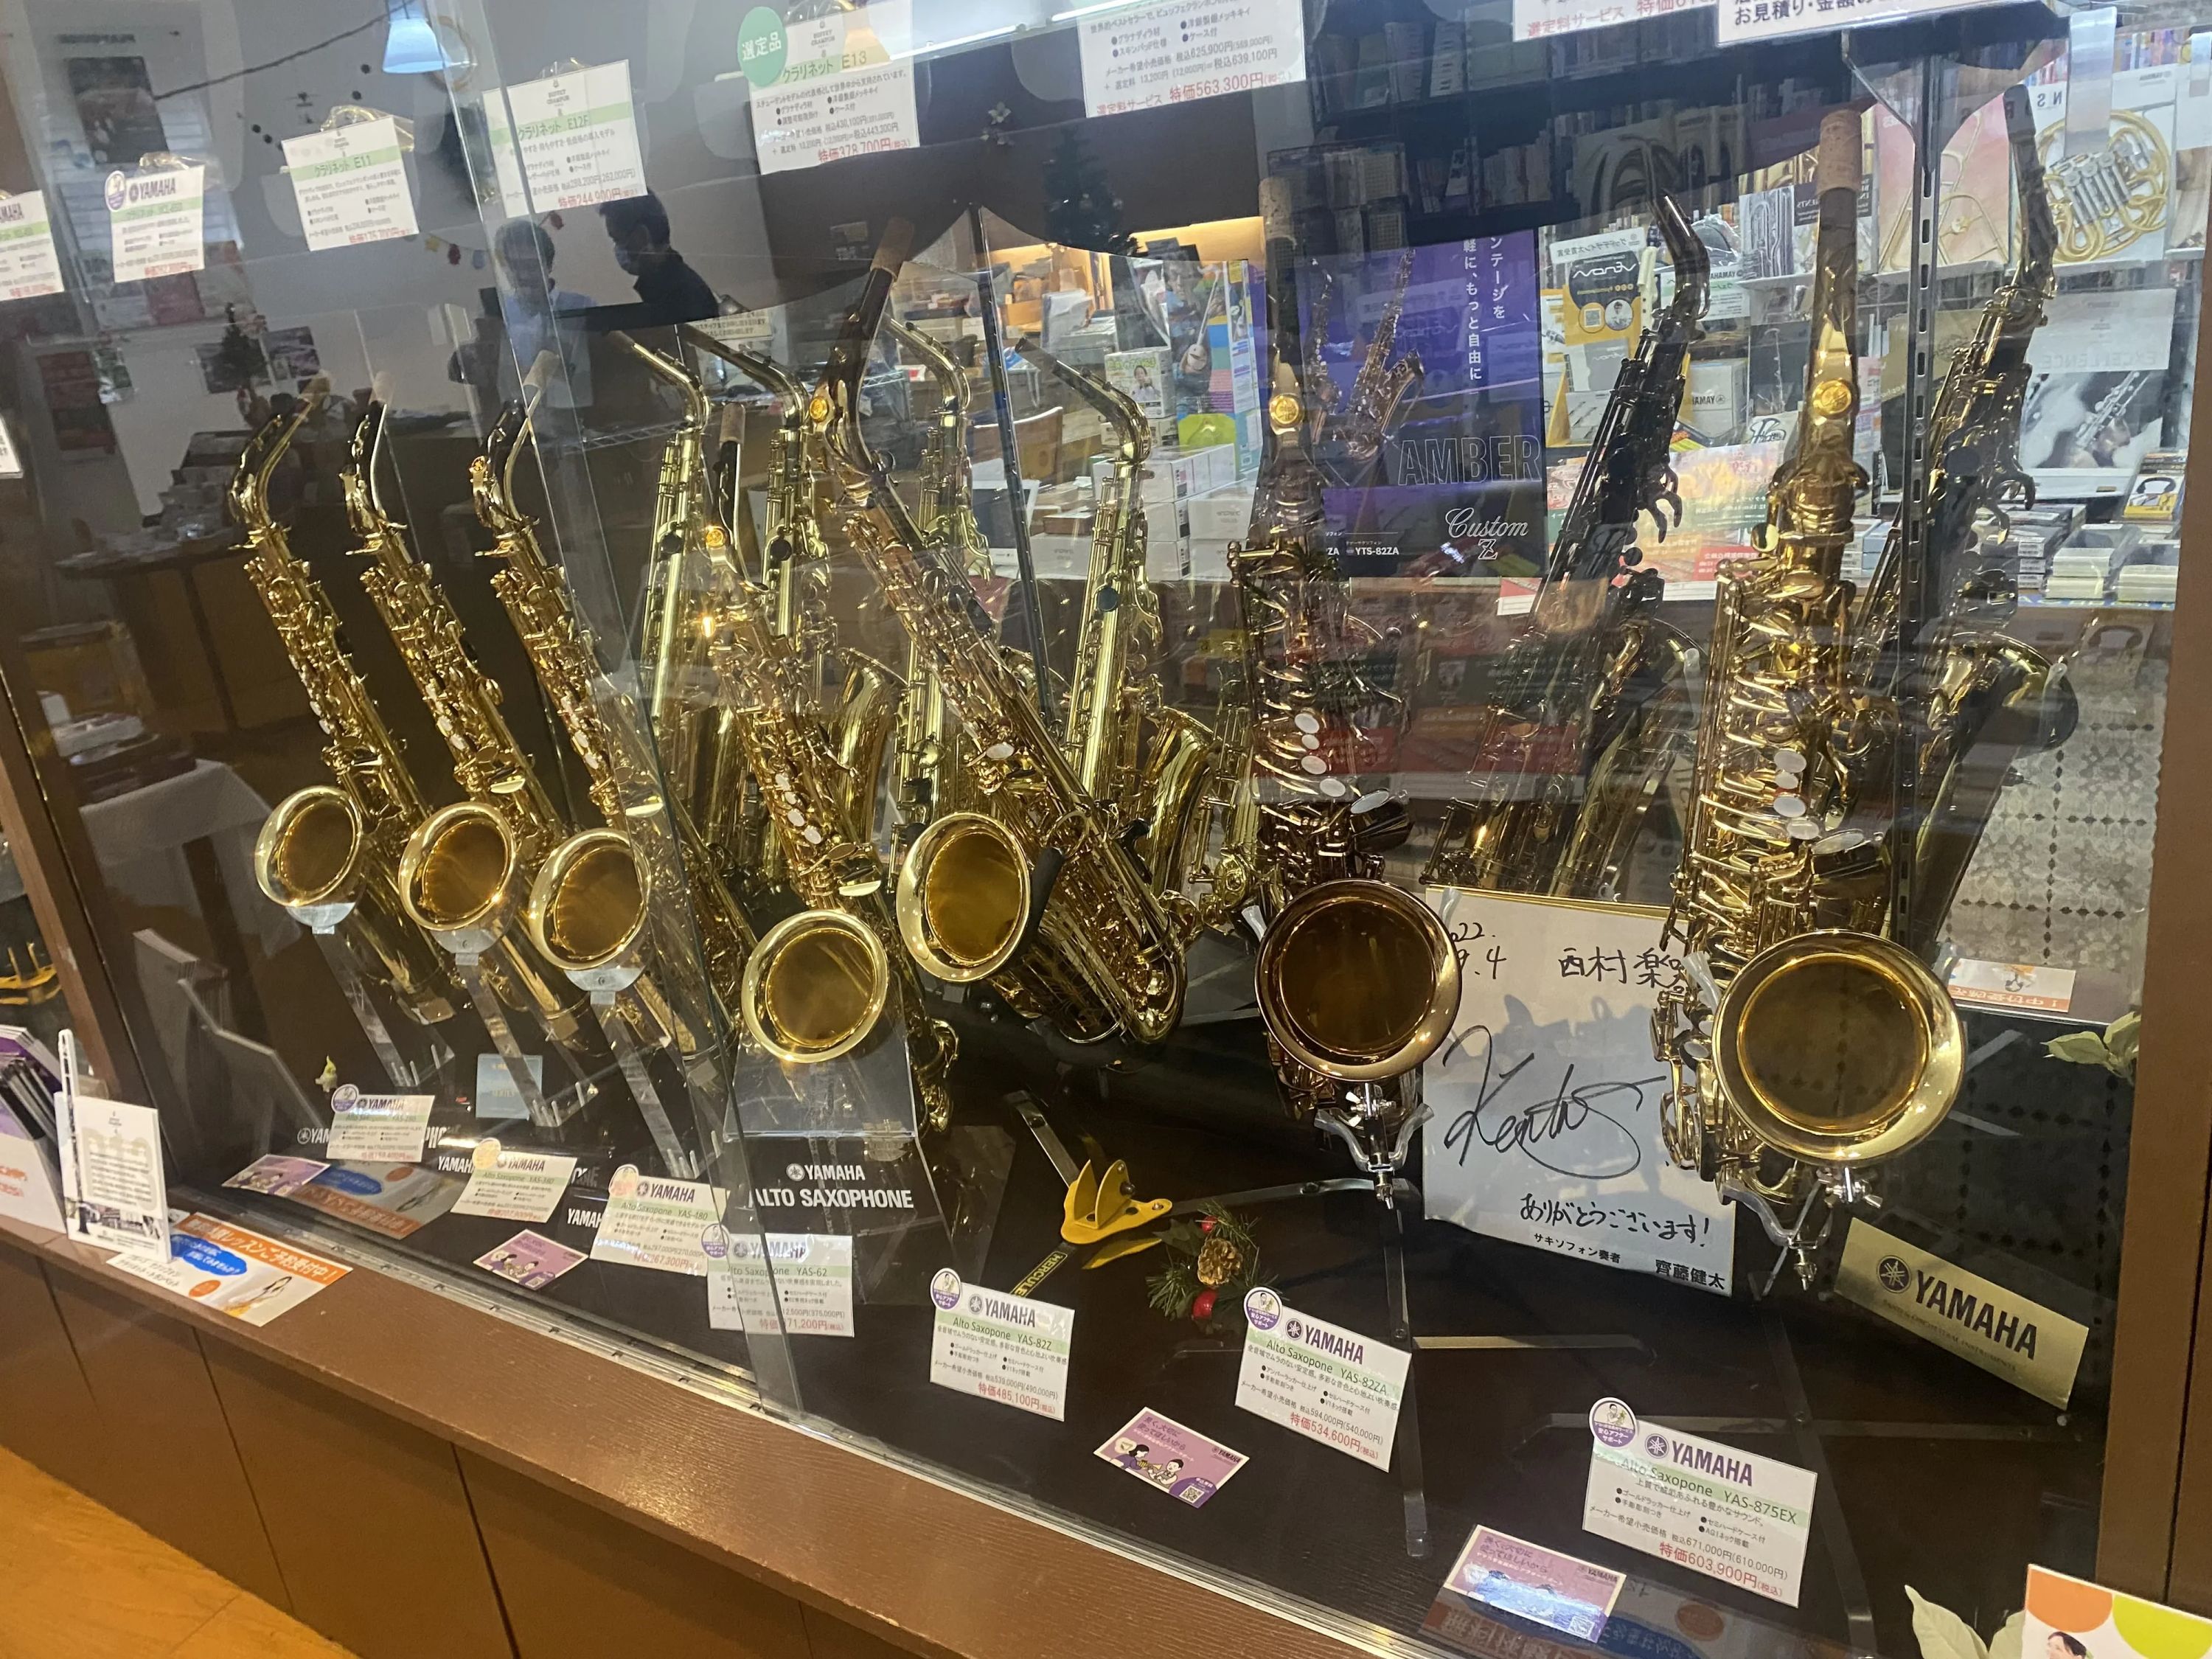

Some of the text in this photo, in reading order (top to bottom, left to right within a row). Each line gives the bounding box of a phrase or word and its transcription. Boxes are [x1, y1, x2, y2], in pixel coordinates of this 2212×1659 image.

[742, 31, 782, 61] 選定品
[783, 52, 868, 83] クラリネット E13
[518, 121, 562, 141] クラリネット
[354, 155, 372, 169] E11
[139, 178, 177, 200] YAMAHA
[1398, 435, 1543, 486] AMBER
[1445, 507, 1528, 538] Custom
[1355, 547, 1399, 556] YTS-82ZA
[369, 1099, 404, 1110] YAMAHA
[509, 1158, 546, 1172] YAMAHA
[804, 1164, 866, 1180] YAMAHA
[621, 1203, 636, 1211] Alto
[650, 1183, 696, 1203] YAMAHA
[748, 1189, 914, 1208] ALTO SAXOPHONE
[1534, 1232, 1621, 1264] サキソフォン奏者
[796, 1267, 828, 1277] YAS-62
[1014, 1252, 1064, 1298] HERCULE
[759, 1318, 844, 1331] 特価71,200円(税込)
[985, 1298, 1036, 1327] YAMAHA
[1915, 1269, 2037, 1360] YAMAHA
[953, 1317, 1052, 1352] Alto Saxopone YAS-82Z
[1304, 1324, 1364, 1365] YAMAHA
[934, 1360, 983, 1380] メーカー希望小売価格
[1265, 1339, 1387, 1395] Alto Saxopone YAS-82ZA
[1241, 1380, 1383, 1444] メーカー希望小売価格 税込594,000円(540,000円)
[1290, 1412, 1379, 1460] 特価534,600円(税込)
[1598, 1427, 1630, 1439] 安心アフター
[1602, 1436, 1624, 1444] サポート
[1218, 1449, 1242, 1464] YAMAHA
[1672, 1440, 1753, 1486] YAMAHA
[1621, 1458, 1798, 1525] Alto Saxopone YAS-875EX
[1623, 1489, 1691, 1517] ゴールドラッカー仕上げ
[1589, 1505, 1788, 1580] メーカー希望小売価格 税込671,000円(610,000円)
[1707, 1517, 1767, 1544] セミハードケース付
[1659, 1541, 1783, 1597] 特価603,900円(税込)
